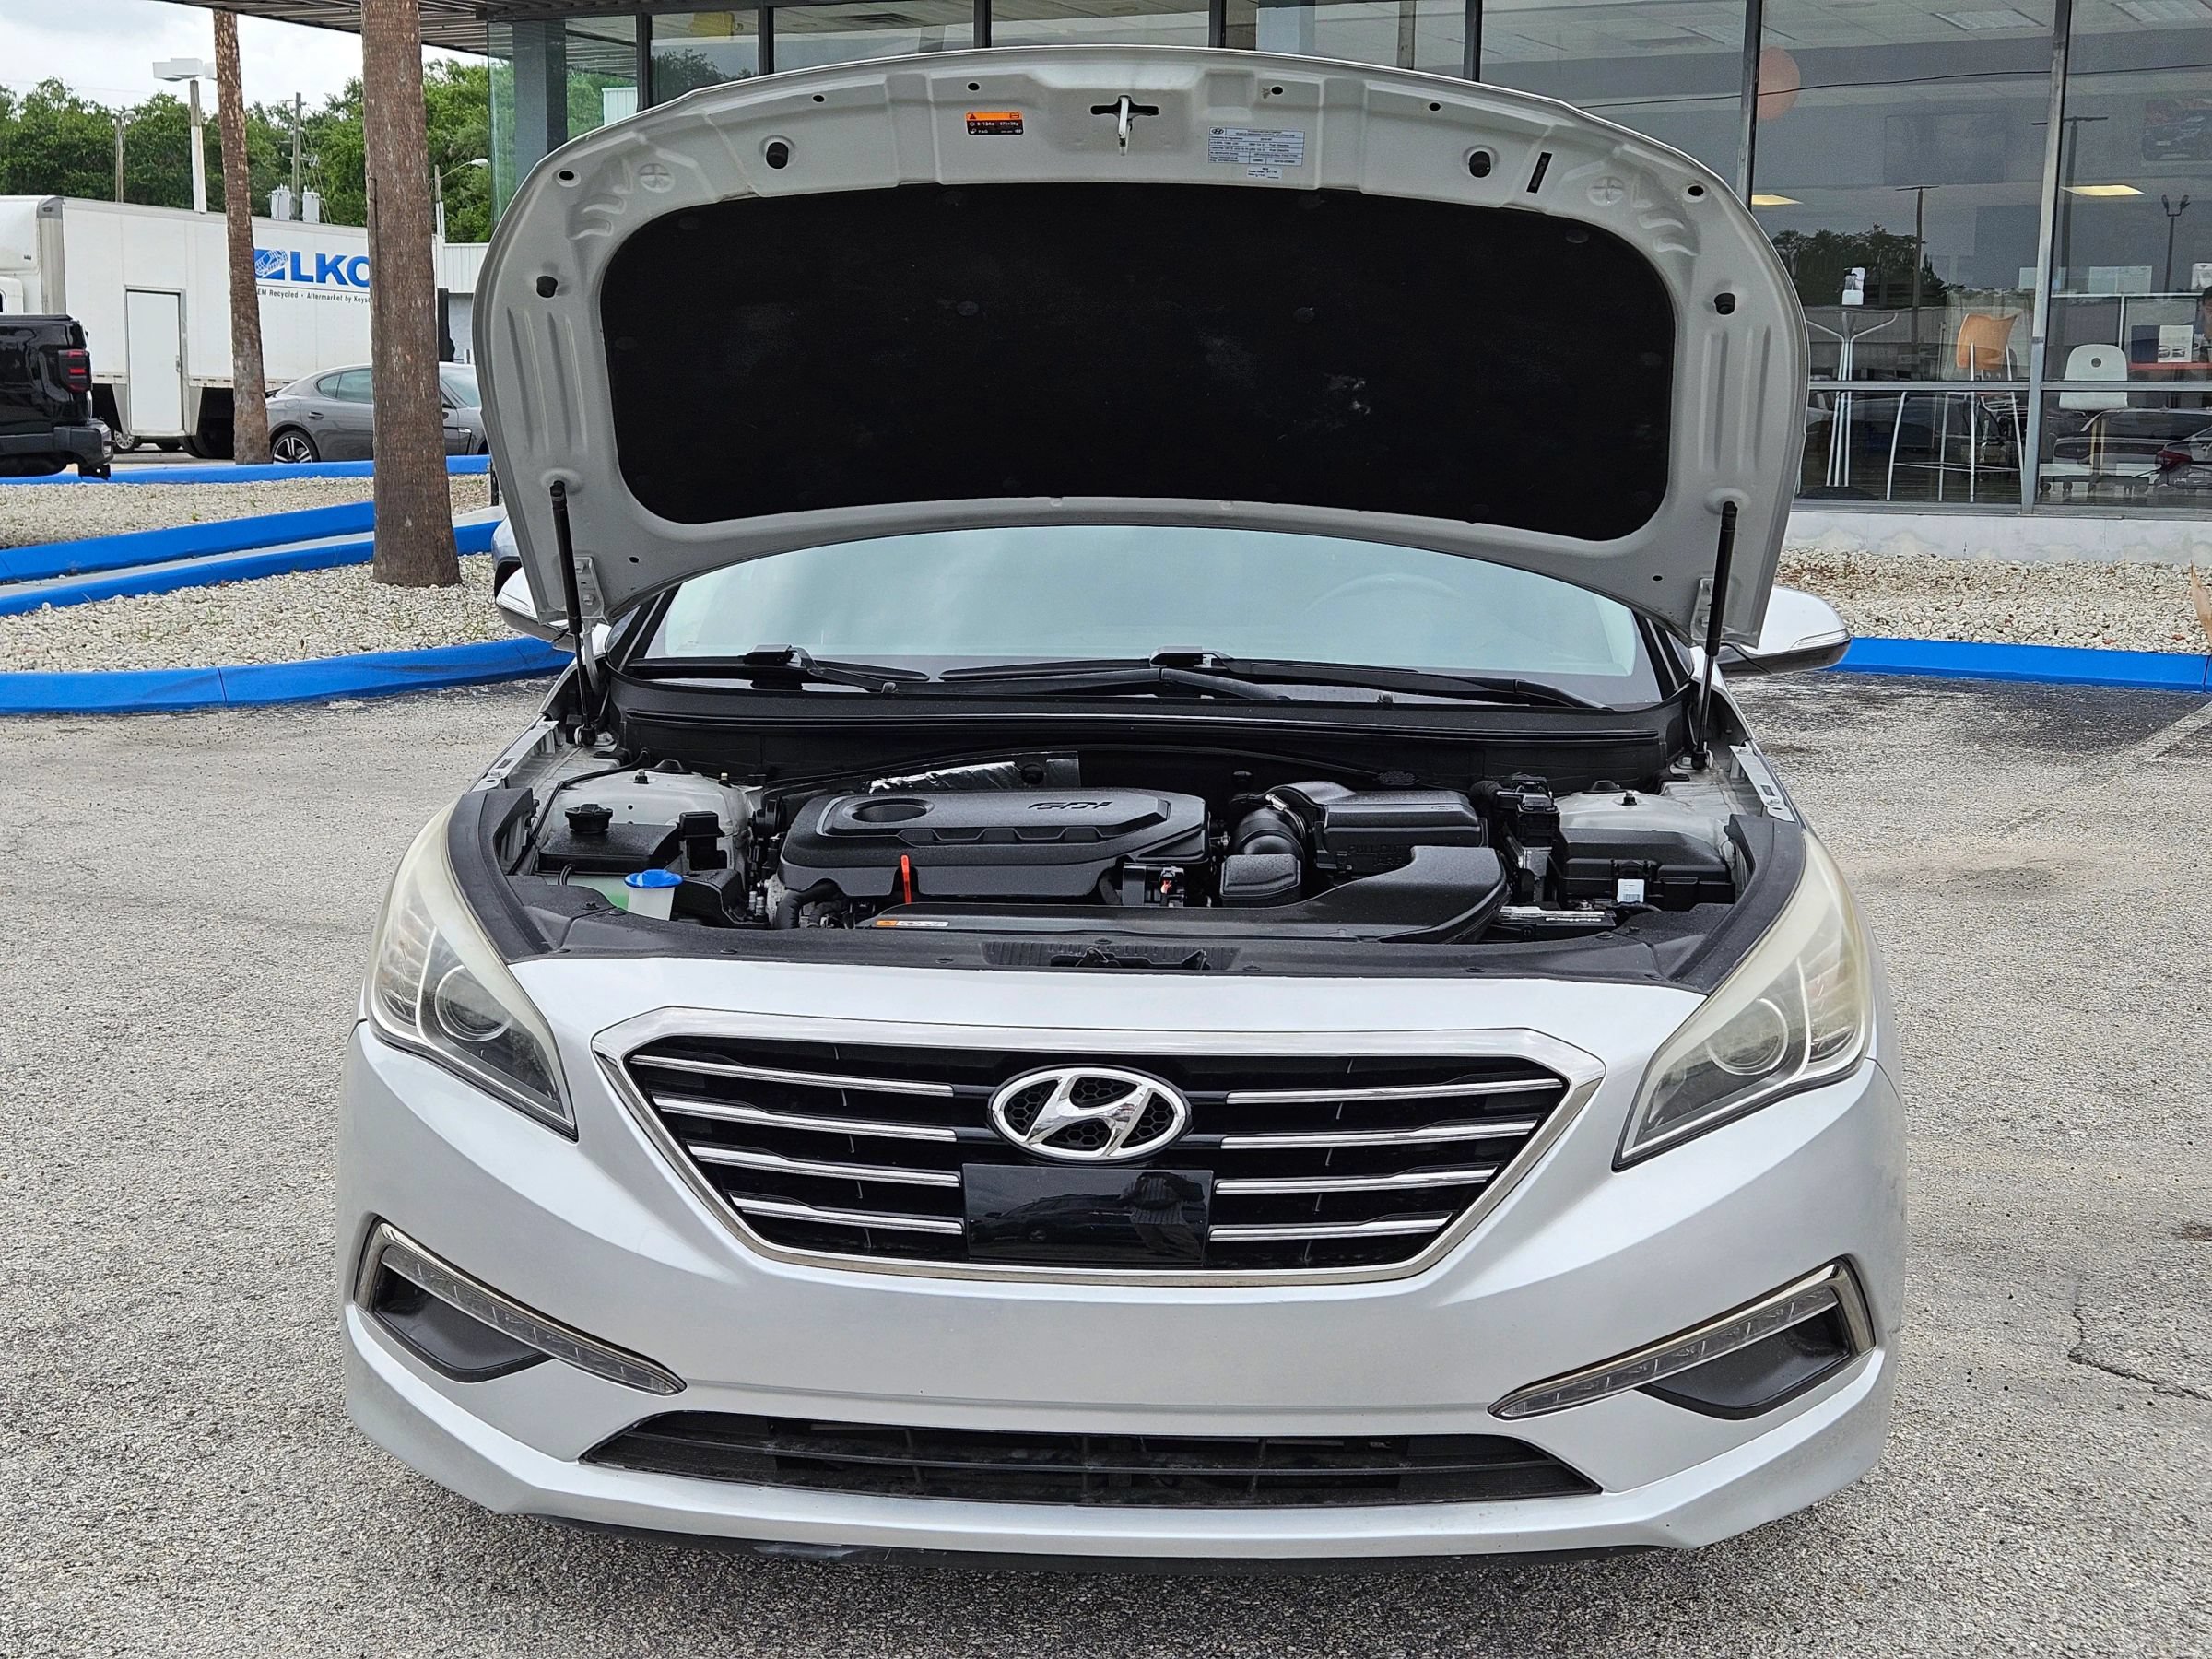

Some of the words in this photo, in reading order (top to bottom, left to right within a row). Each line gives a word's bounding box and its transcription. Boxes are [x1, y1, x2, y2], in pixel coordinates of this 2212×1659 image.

[269, 289, 298, 299] Recycled
[307, 292, 343, 301] Aftermarket
[345, 295, 352, 303] by
